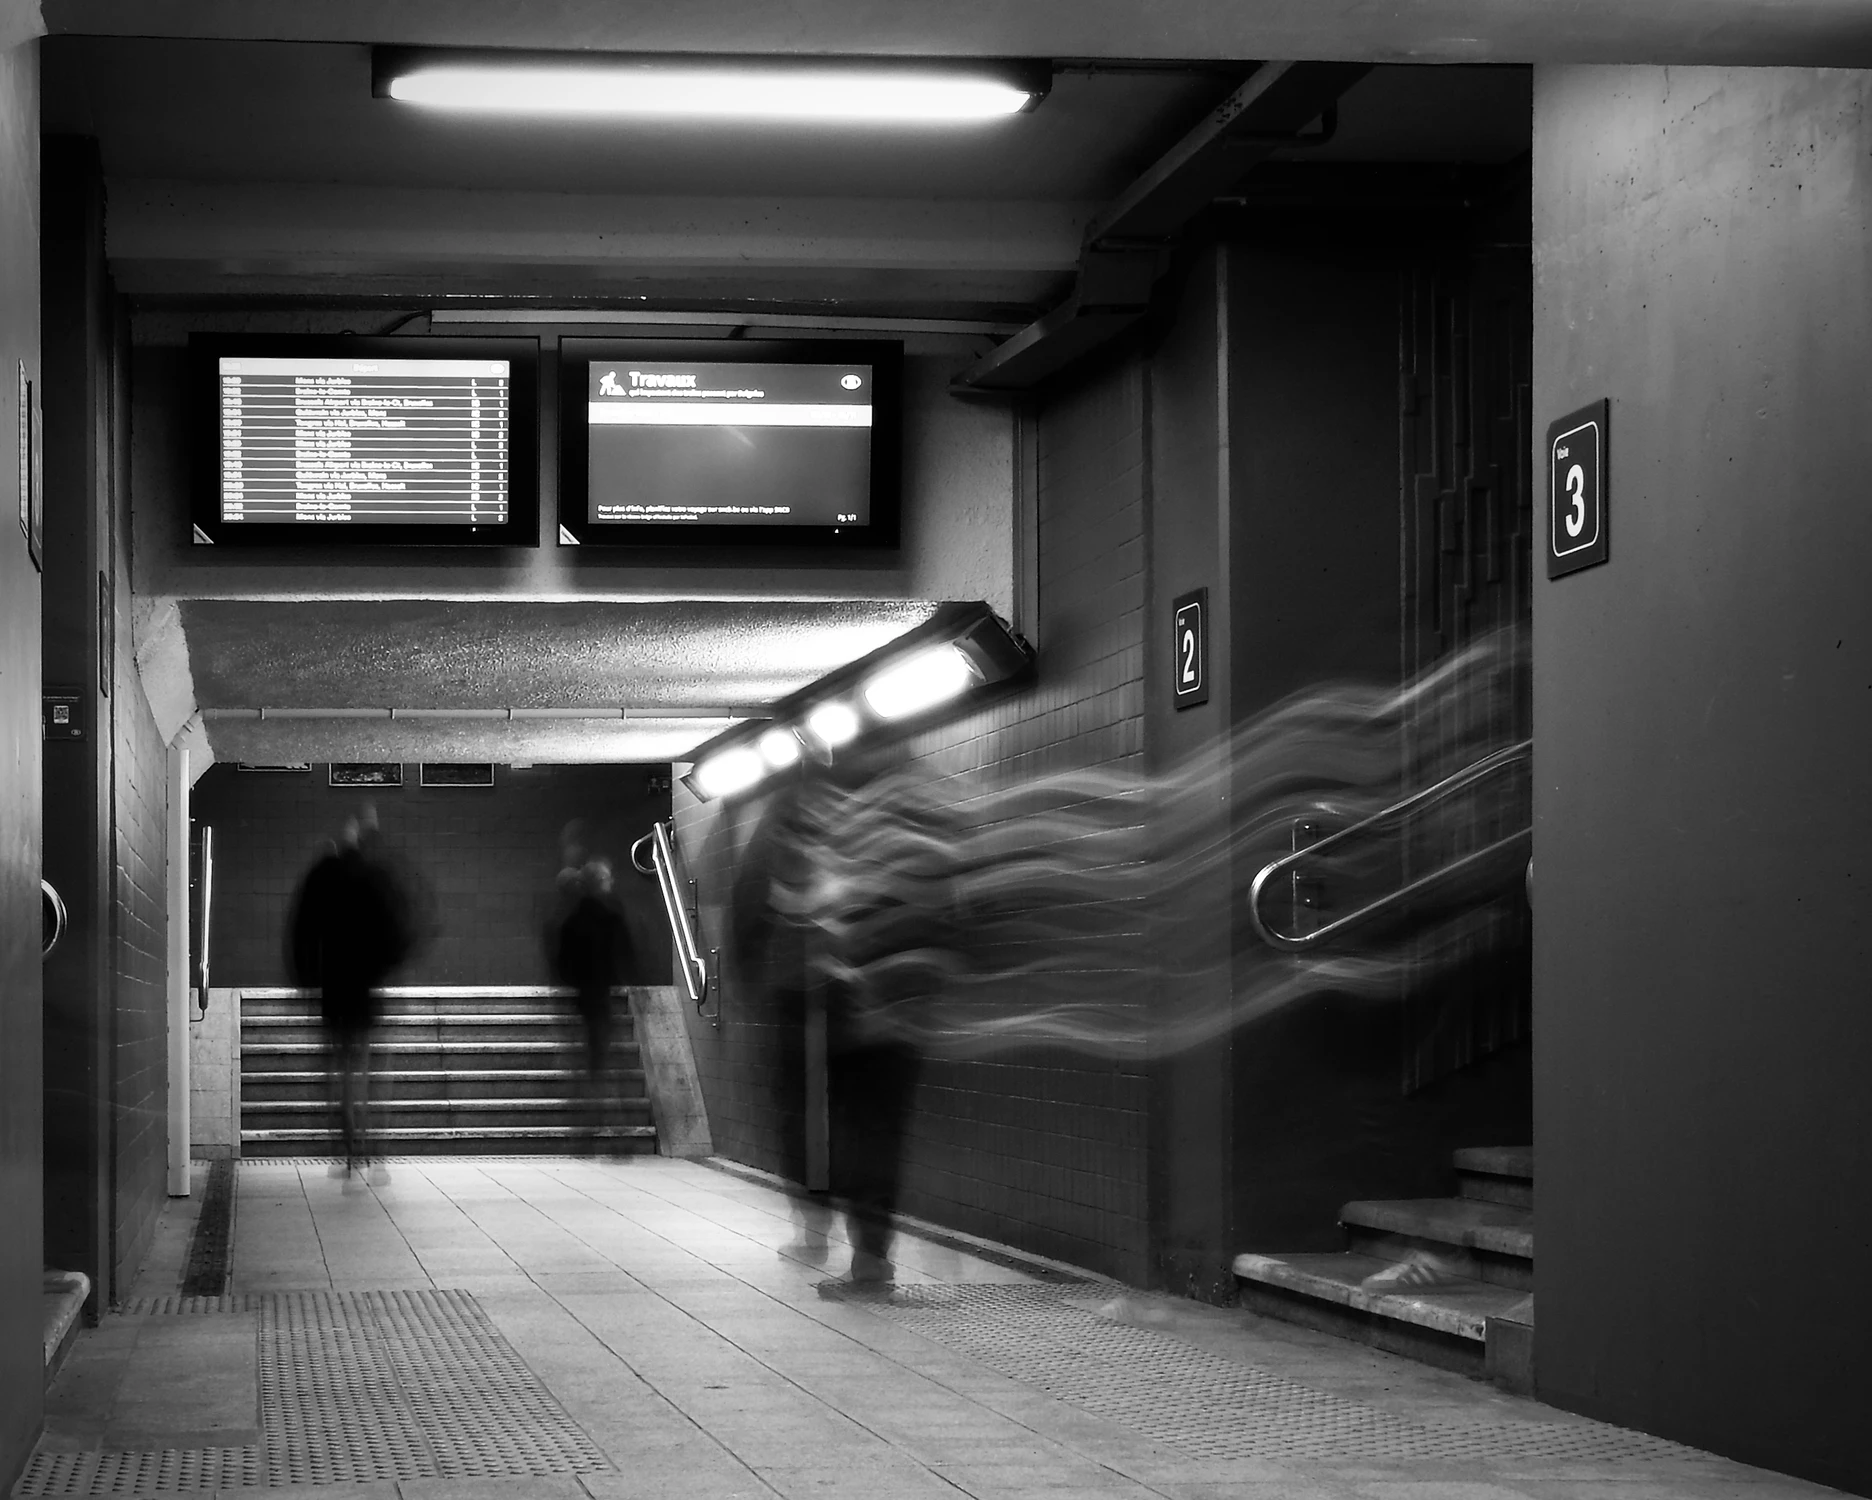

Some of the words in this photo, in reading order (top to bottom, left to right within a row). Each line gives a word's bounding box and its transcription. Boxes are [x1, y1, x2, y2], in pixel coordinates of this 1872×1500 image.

[629, 371, 696, 388] Travaux
[1566, 465, 1584, 536] 3
[1183, 630, 1194, 682] 2
